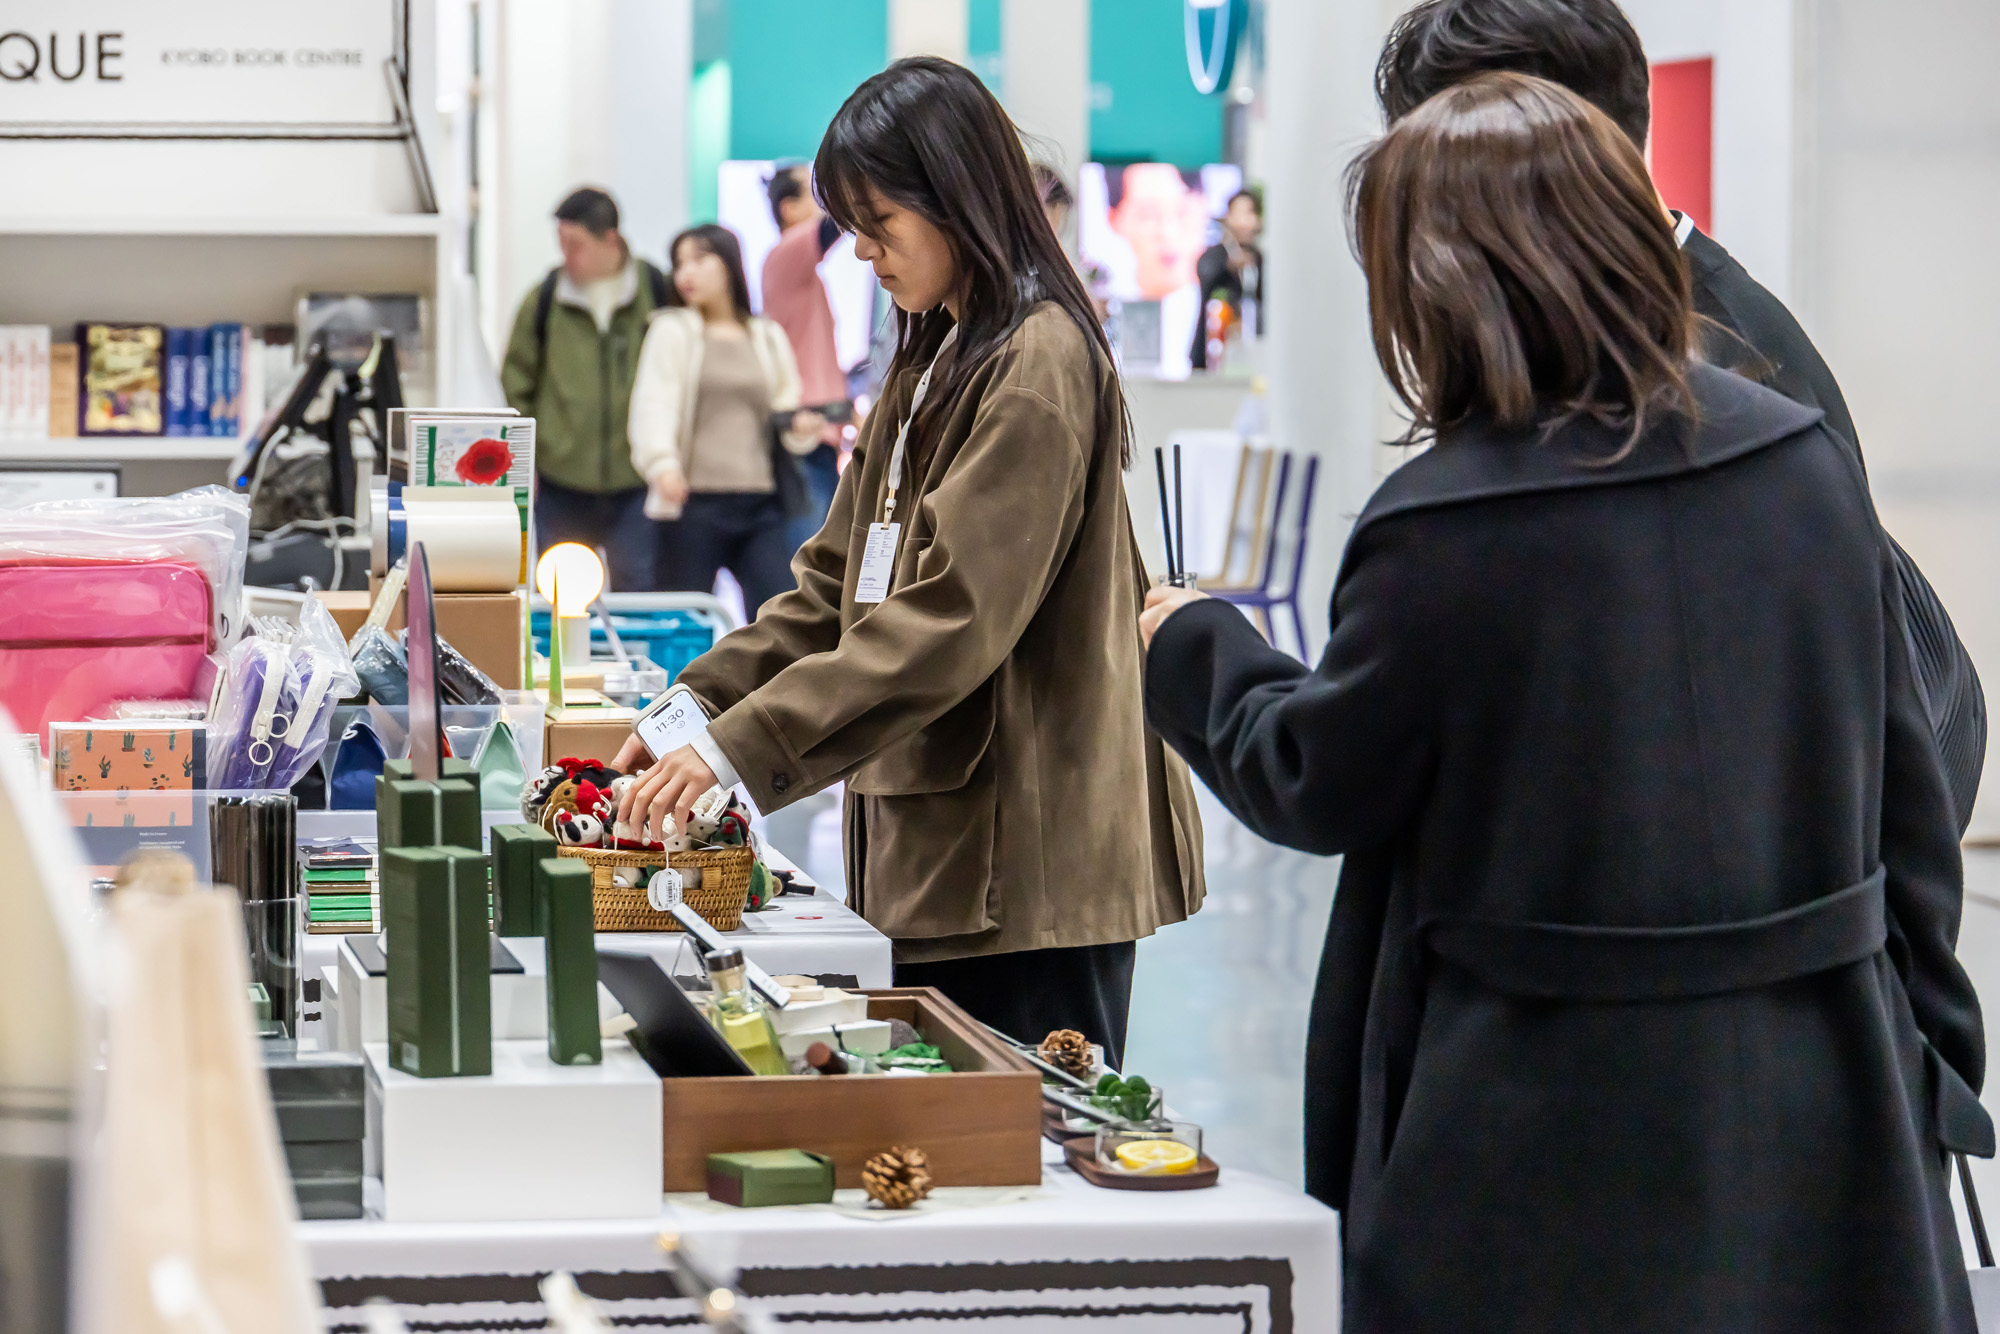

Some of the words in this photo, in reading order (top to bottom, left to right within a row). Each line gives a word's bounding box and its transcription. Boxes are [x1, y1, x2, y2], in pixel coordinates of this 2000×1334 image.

[0, 32, 122, 82] QUE
[161, 48, 229, 66] KYOBO
[233, 48, 288, 66] BOOK
[293, 48, 364, 66] CENTRE
[655, 708, 684, 733] 11:30
